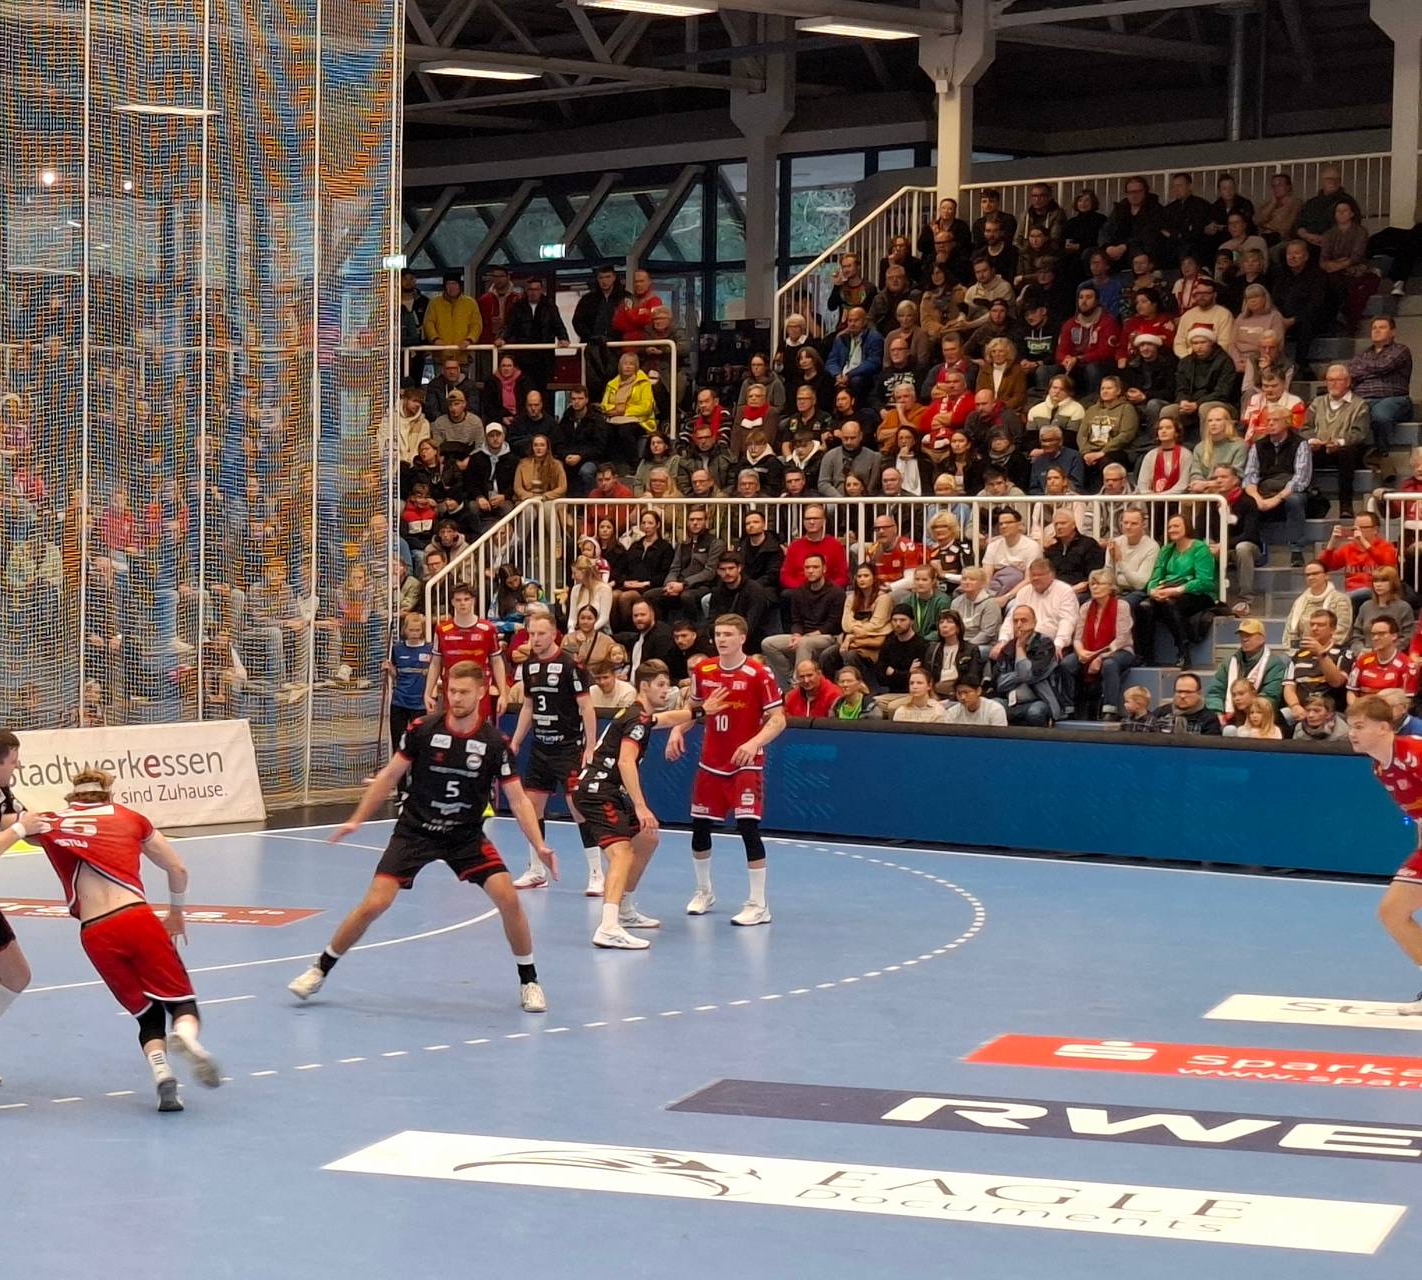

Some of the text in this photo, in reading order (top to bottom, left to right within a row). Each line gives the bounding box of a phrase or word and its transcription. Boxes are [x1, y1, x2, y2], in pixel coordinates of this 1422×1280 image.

[537, 694, 547, 712] 3
[715, 715, 729, 732] 10
[121, 786, 153, 805] sind
[157, 782, 228, 801] Zuhause.
[445, 780, 460, 798] 5
[1178, 1067, 1422, 1088] www.spar
[880, 1097, 1422, 1157] RWE
[815, 1170, 1253, 1219] EAGLE
[796, 1188, 1223, 1233] Documents
